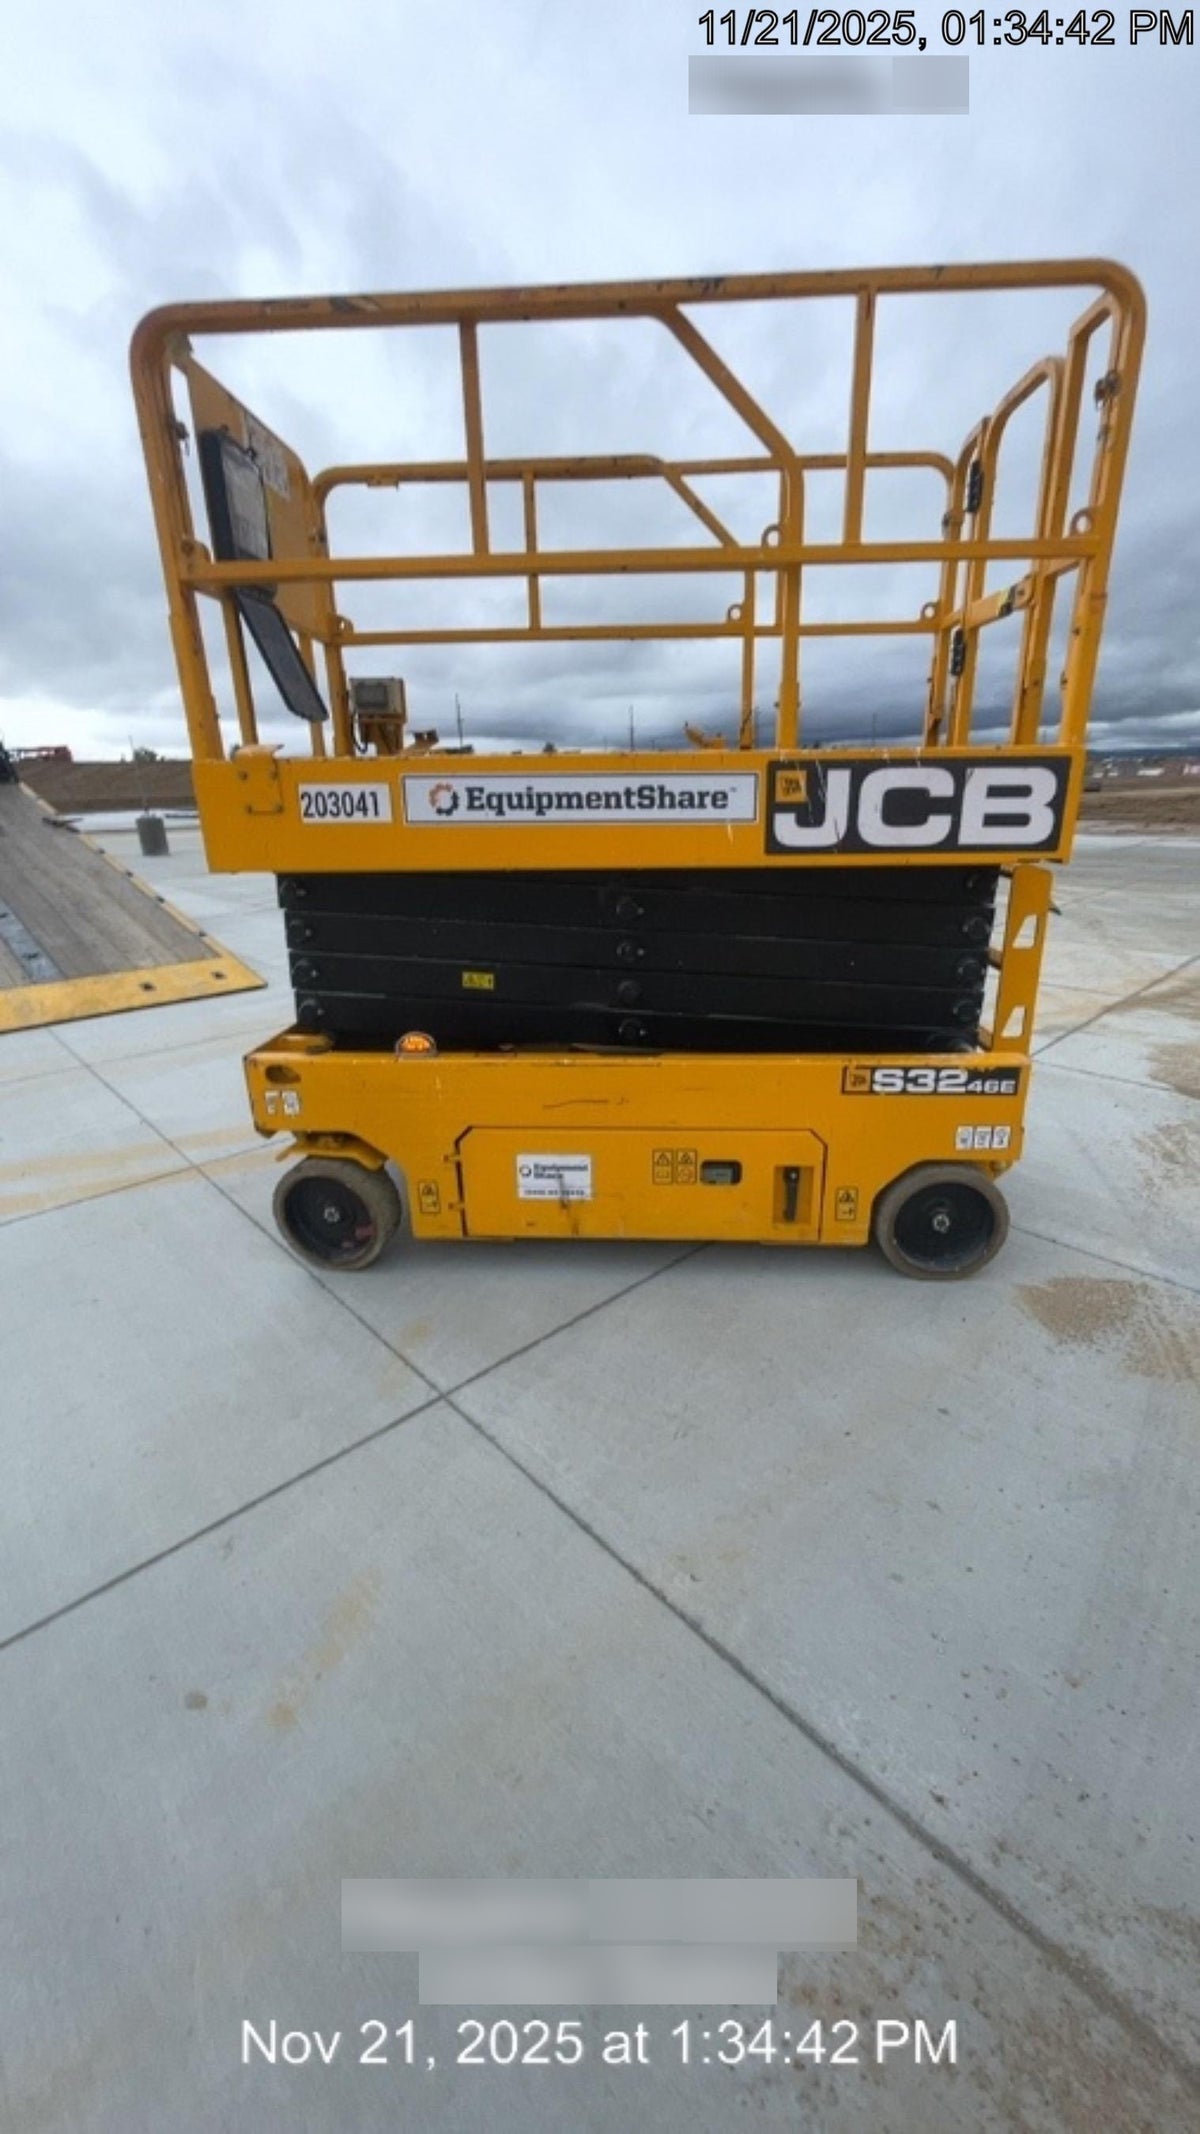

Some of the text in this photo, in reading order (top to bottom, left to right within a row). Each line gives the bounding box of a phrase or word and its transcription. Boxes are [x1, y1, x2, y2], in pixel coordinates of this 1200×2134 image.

[302, 791, 380, 819] 203041
[464, 784, 730, 815] EquipmentShare
[773, 767, 1058, 847] JCB
